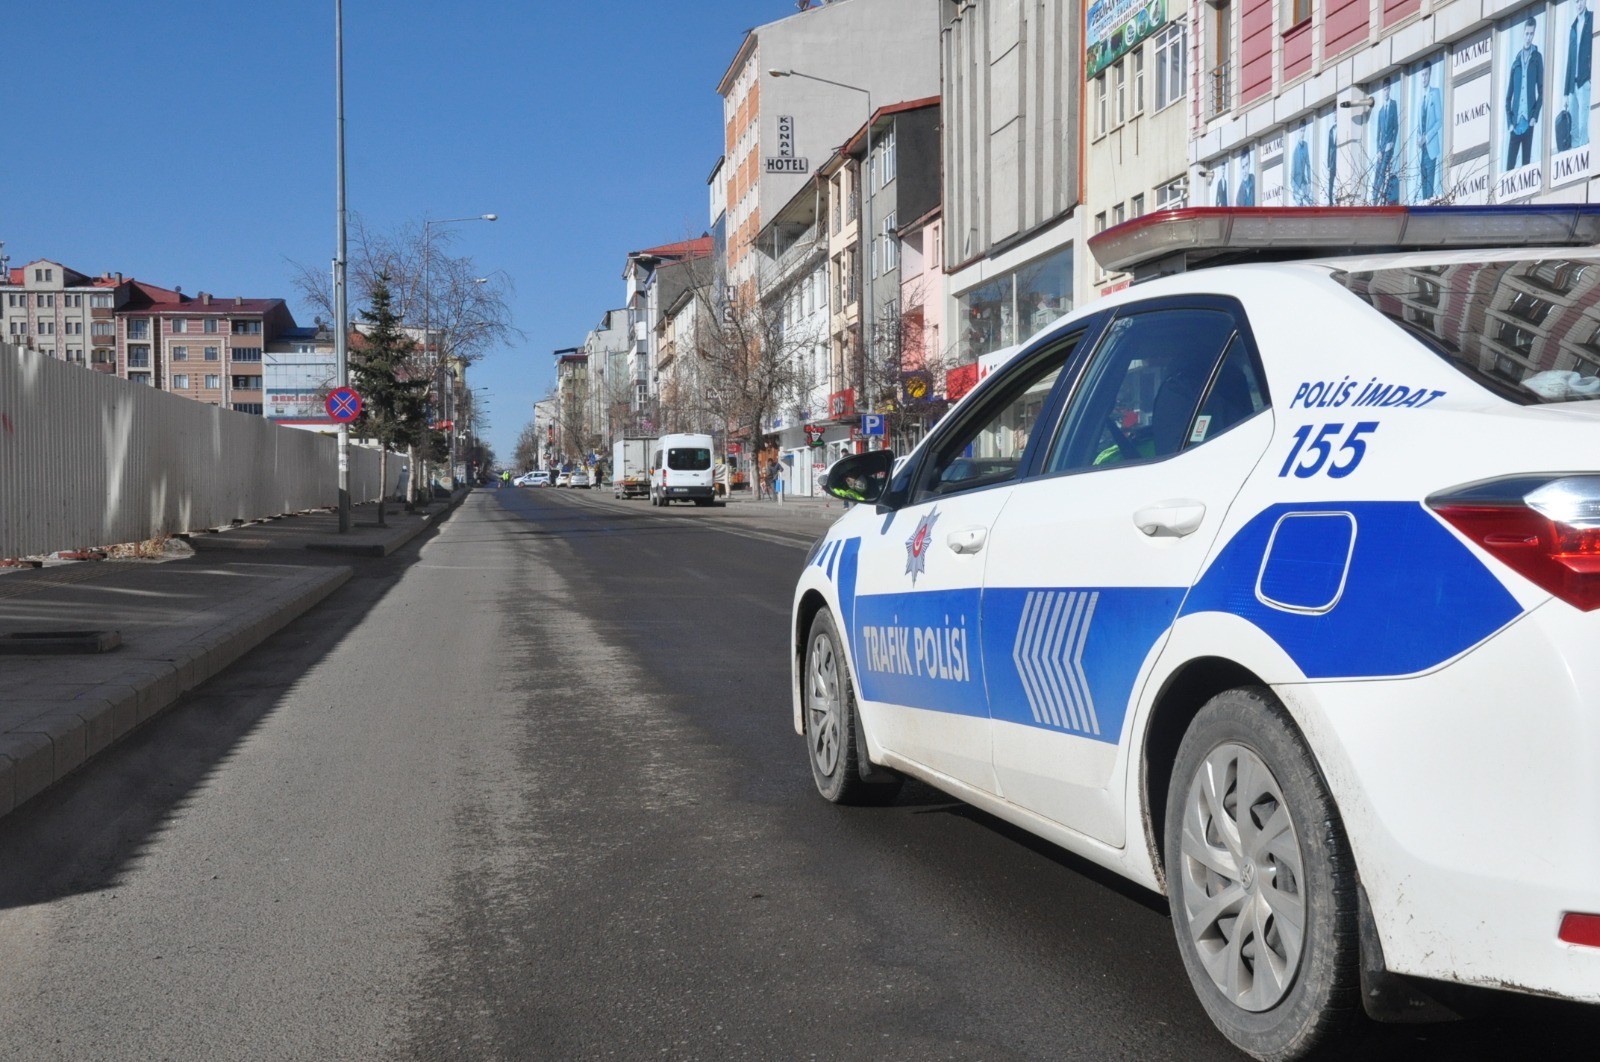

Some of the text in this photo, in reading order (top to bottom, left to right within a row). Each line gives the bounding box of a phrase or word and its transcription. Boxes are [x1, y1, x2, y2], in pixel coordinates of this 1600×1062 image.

[779, 117, 790, 156] KONAK
[767, 158, 805, 171] HOTEL
[1553, 150, 1590, 181] JAKAM
[1289, 375, 1447, 409] POLİS İMDAT
[865, 415, 880, 434] P
[1278, 421, 1380, 479] 155
[863, 613, 970, 682] TRAFİK POLİSİ
